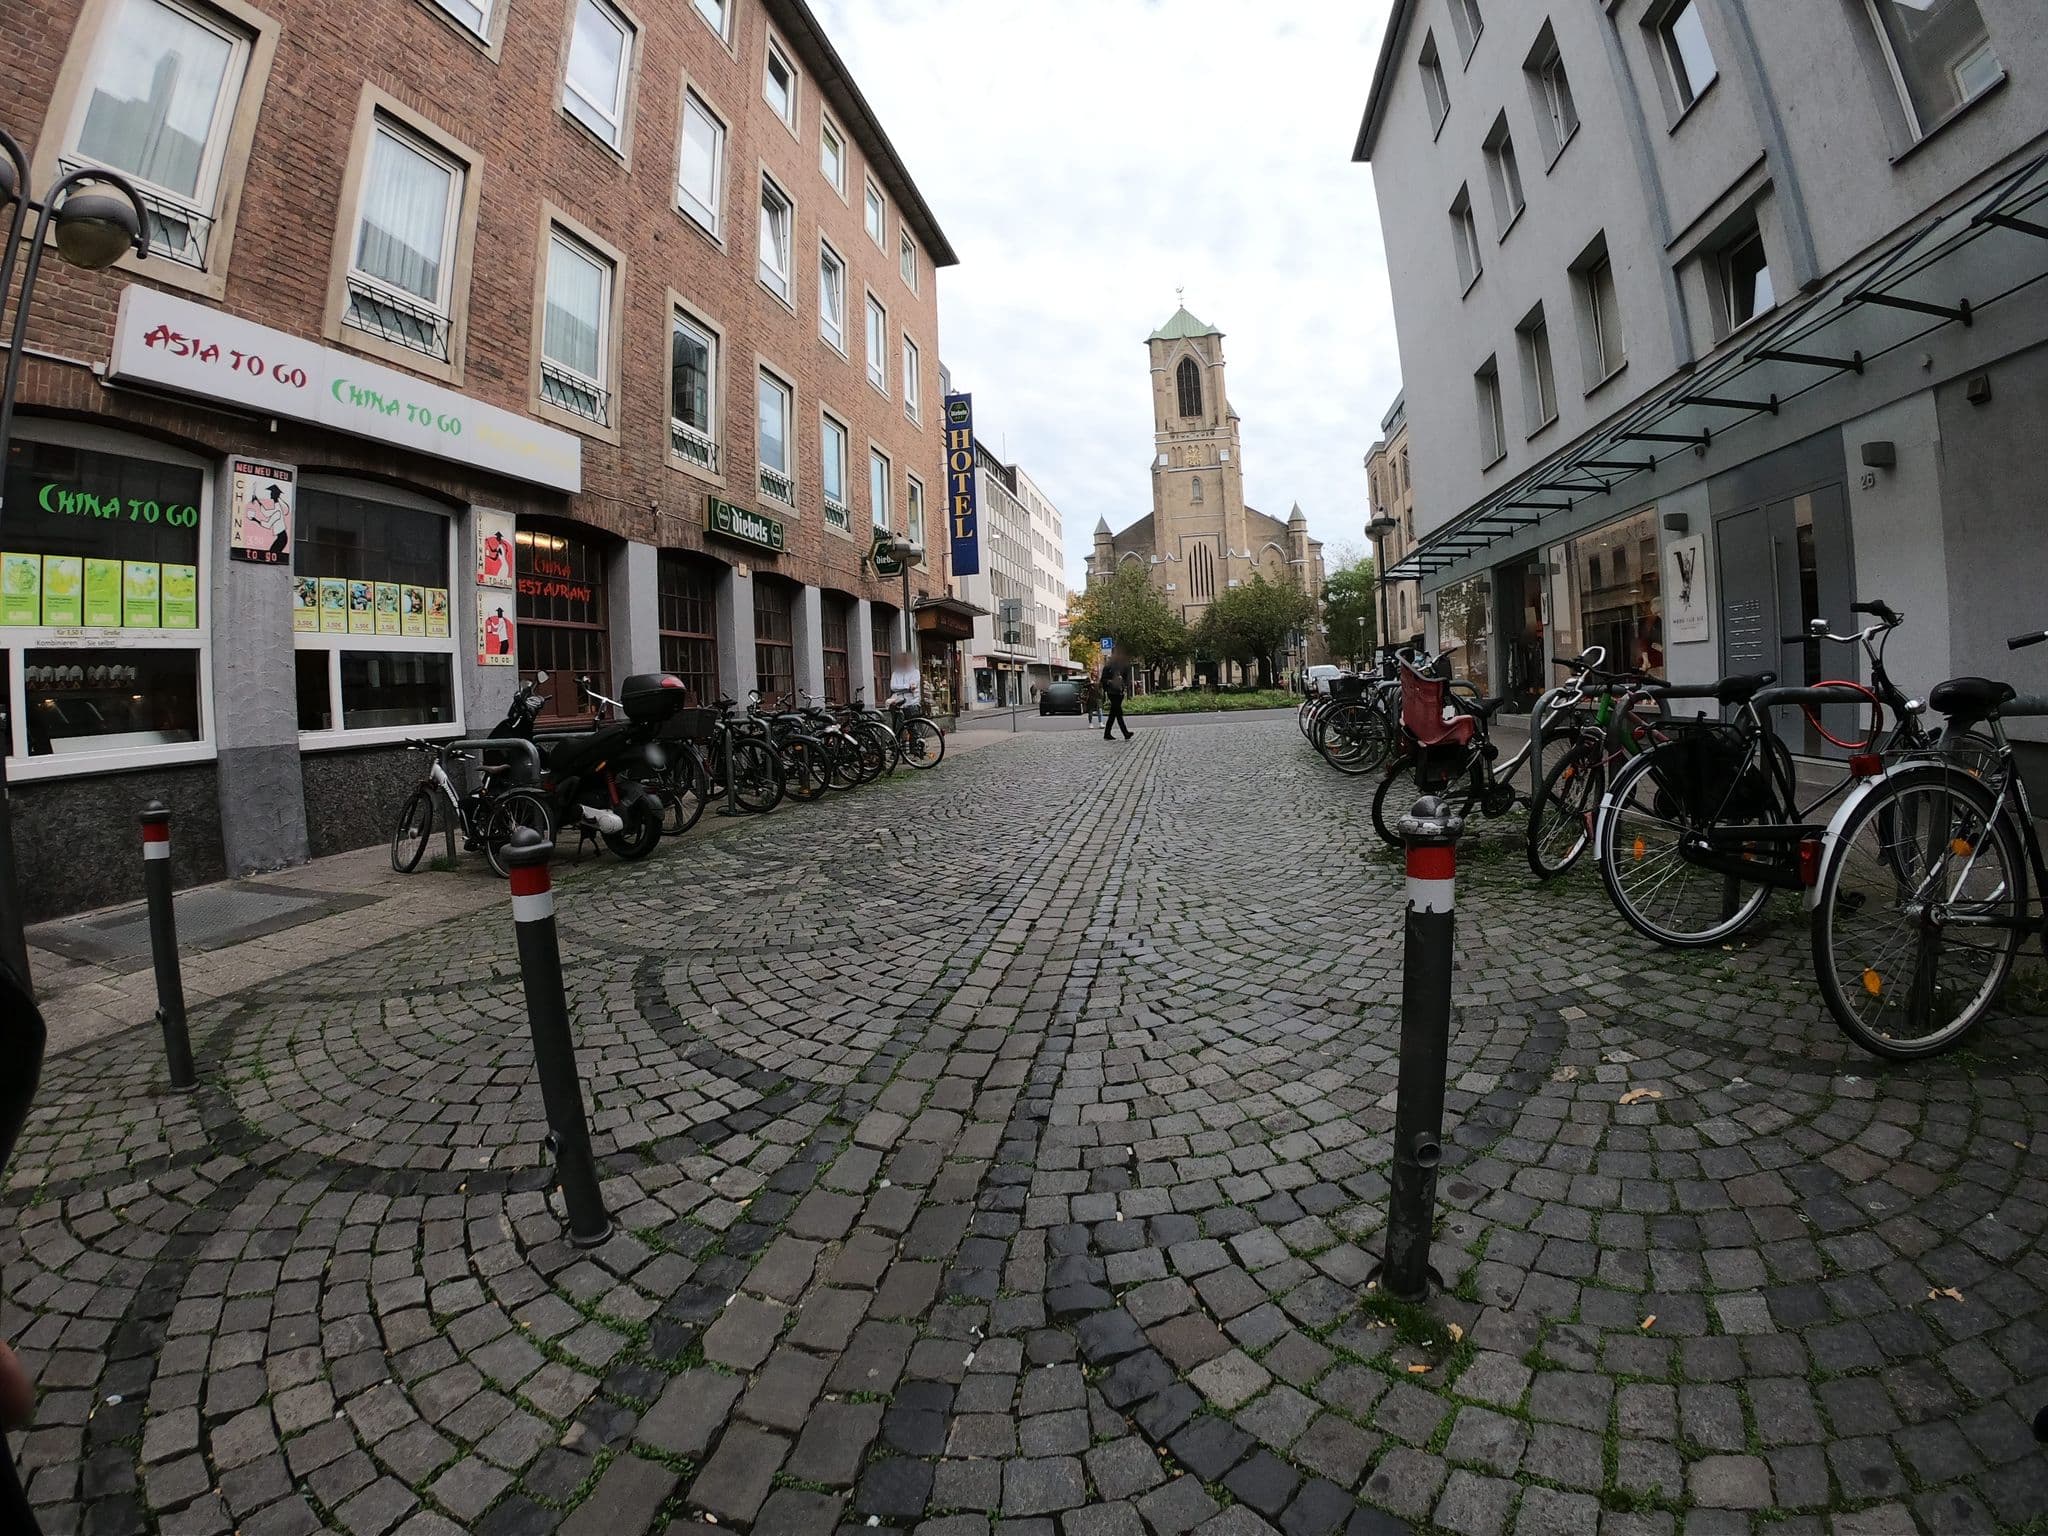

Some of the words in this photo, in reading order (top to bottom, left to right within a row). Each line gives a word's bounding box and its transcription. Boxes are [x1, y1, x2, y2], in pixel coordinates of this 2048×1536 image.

[144, 324, 219, 363] ASIA
[230, 350, 264, 376] TO
[273, 364, 306, 389] GO
[331, 378, 400, 416] CHINA
[406, 403, 432, 427] TO
[437, 414, 462, 436] GO
[236, 462, 253, 474] NEU
[254, 466, 271, 477] NEU
[273, 470, 289, 480] NEU
[949, 428, 974, 539] HOTEL
[38, 483, 120, 519] CHINA
[128, 500, 160, 524] TO
[166, 504, 198, 528] GO
[234, 480, 244, 541] CHINA
[731, 506, 768, 543] Diebels
[245, 550, 258, 560] to
[265, 552, 278, 562] go
[517, 579, 592, 602] ESTAURANT
